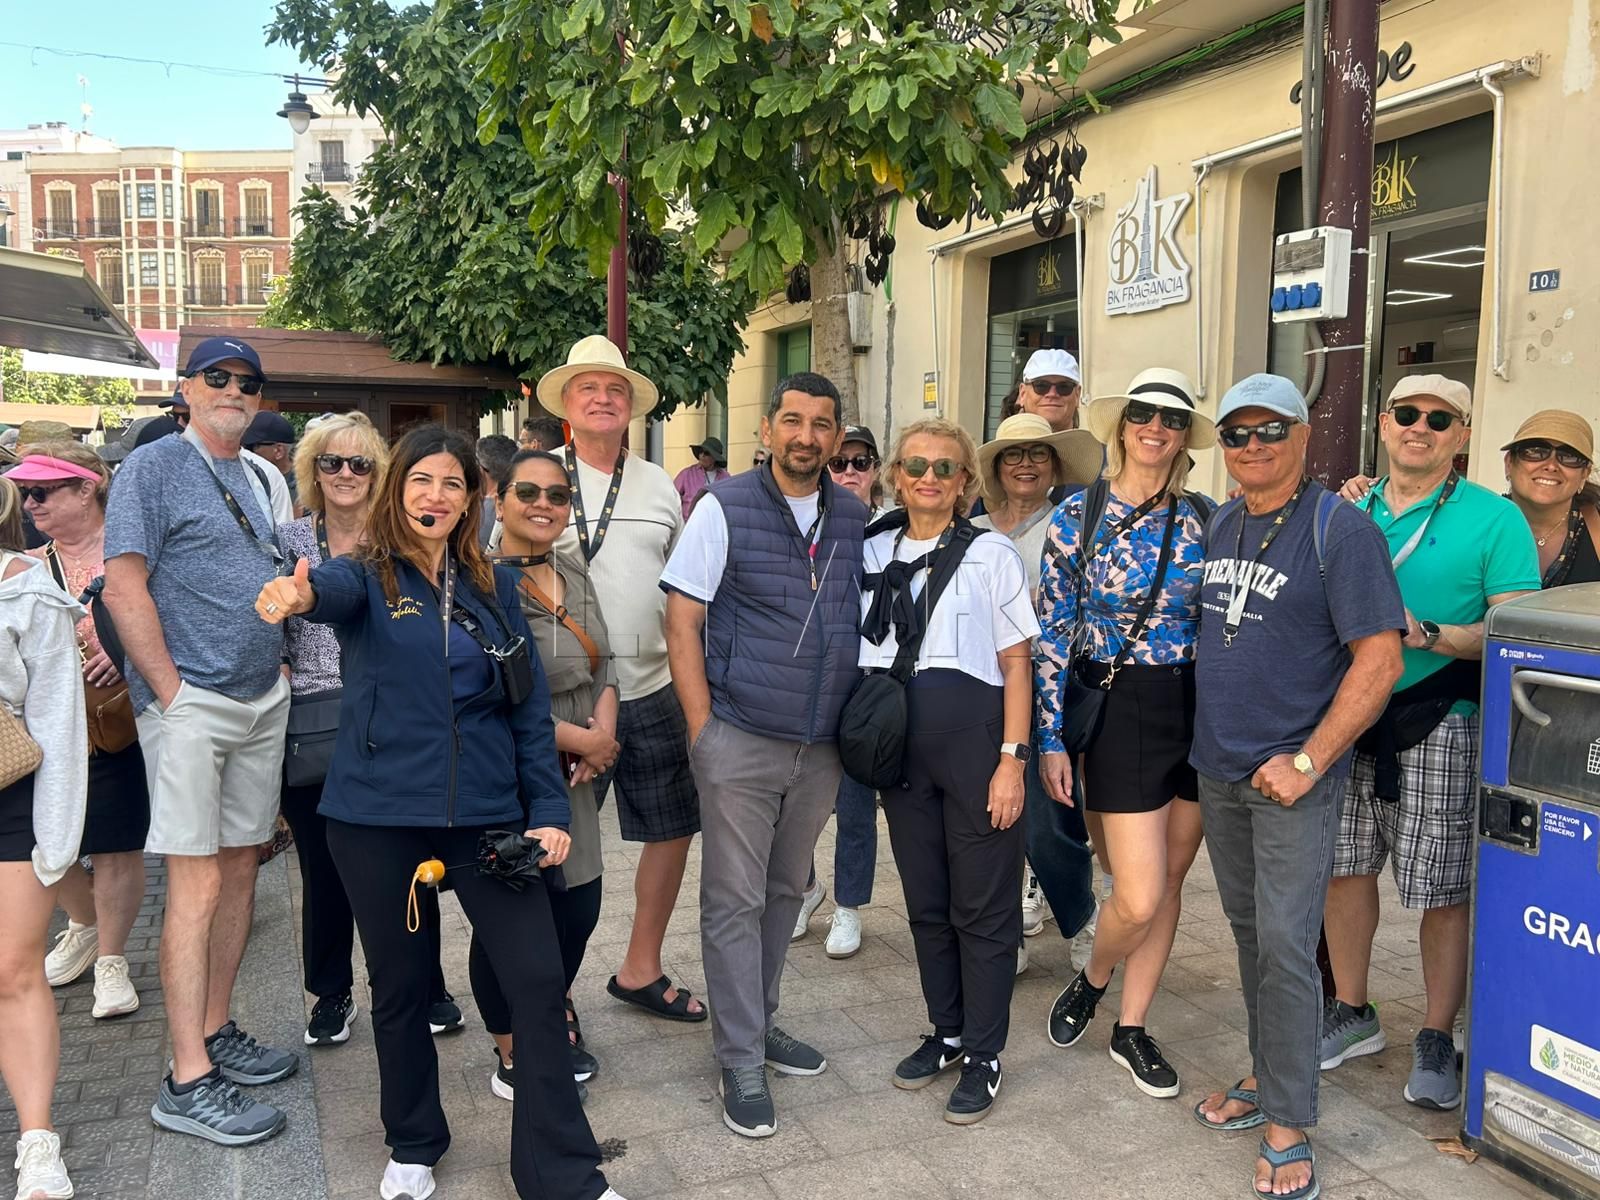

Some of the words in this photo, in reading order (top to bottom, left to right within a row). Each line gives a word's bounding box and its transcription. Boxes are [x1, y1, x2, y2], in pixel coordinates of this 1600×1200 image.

[1531, 274, 1549, 290] 10
[1107, 289, 1120, 305] BK
[1122, 276, 1184, 303] FRAGANCIA
[1544, 811, 1558, 821] POR
[1558, 814, 1580, 826] FAVOR
[1544, 817, 1558, 827] USA
[1558, 821, 1567, 829] EL
[1543, 824, 1576, 838] CENICERO
[1523, 905, 1600, 955] GRA
[1563, 1051, 1592, 1070] MEDIO
